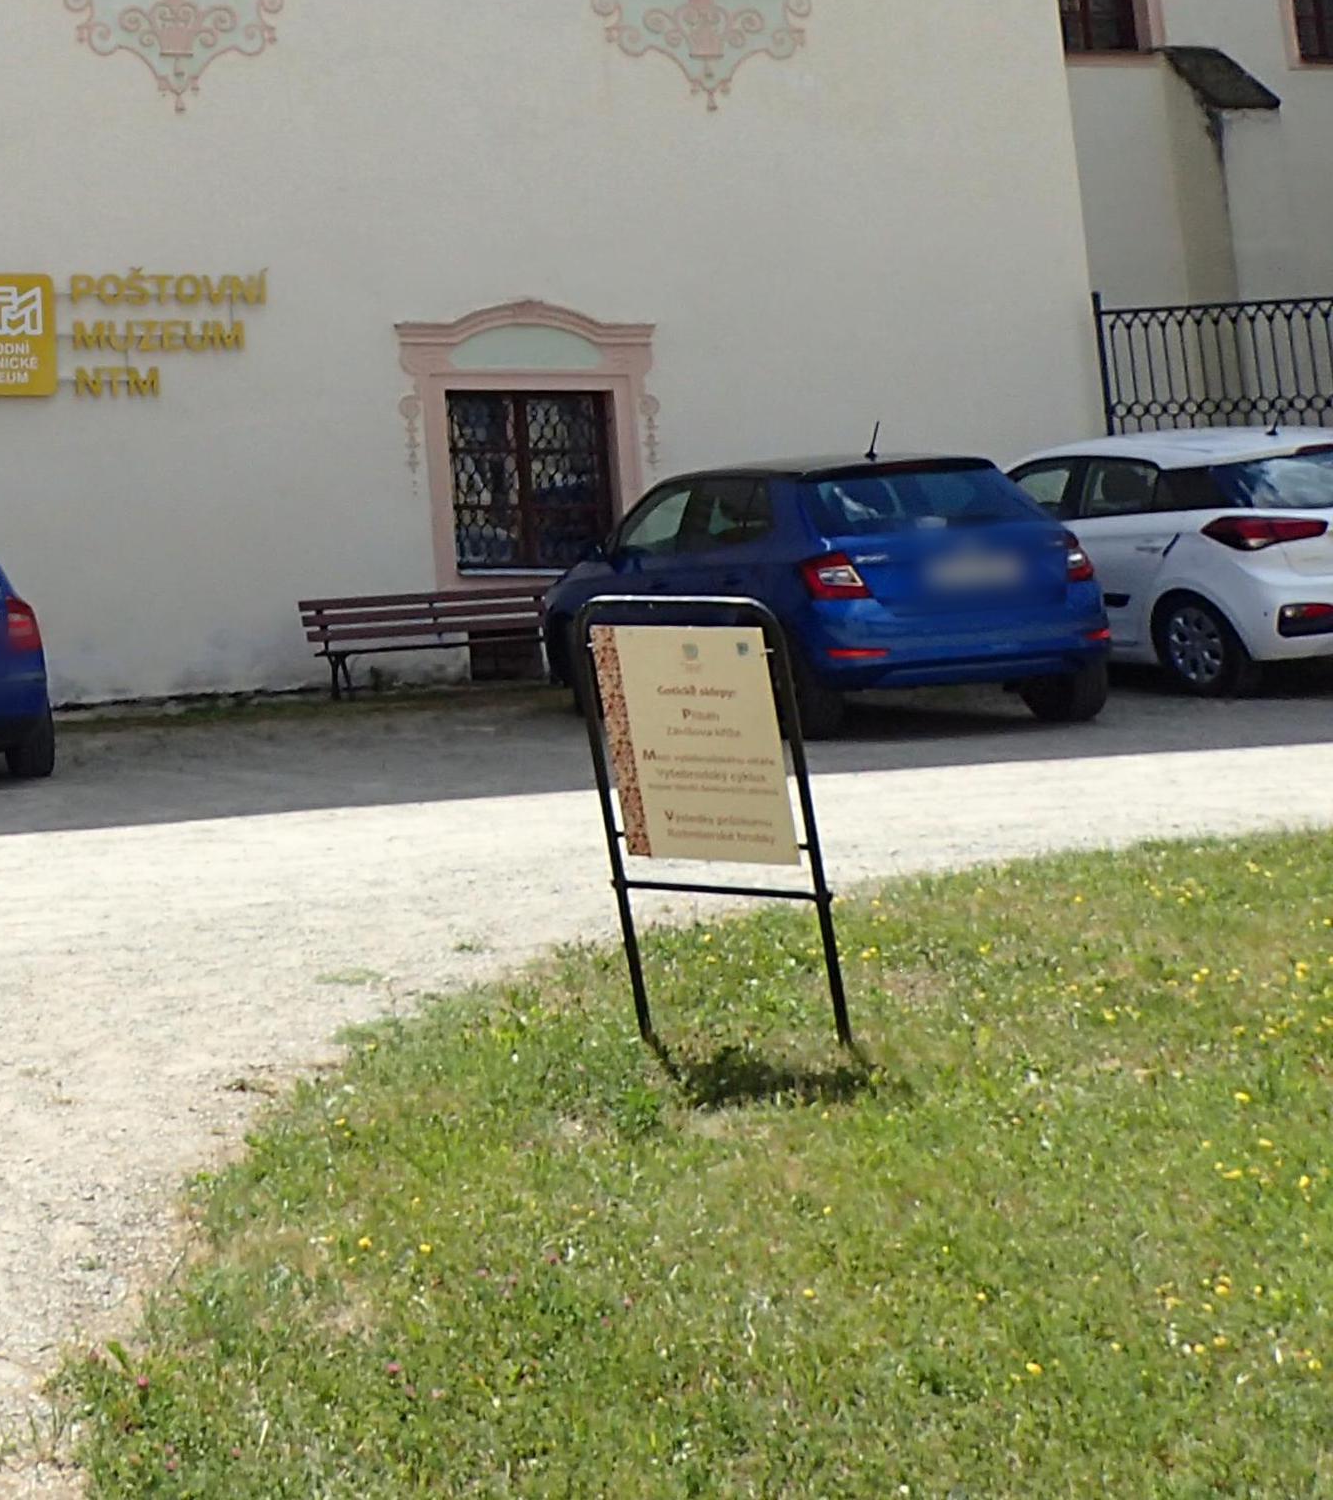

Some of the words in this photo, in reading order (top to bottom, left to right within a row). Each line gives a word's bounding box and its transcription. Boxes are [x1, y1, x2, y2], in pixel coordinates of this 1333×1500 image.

[70, 266, 268, 306] POŠTOVNÍ
[72, 319, 245, 352] MUZEUM
[74, 366, 161, 398] NTM
